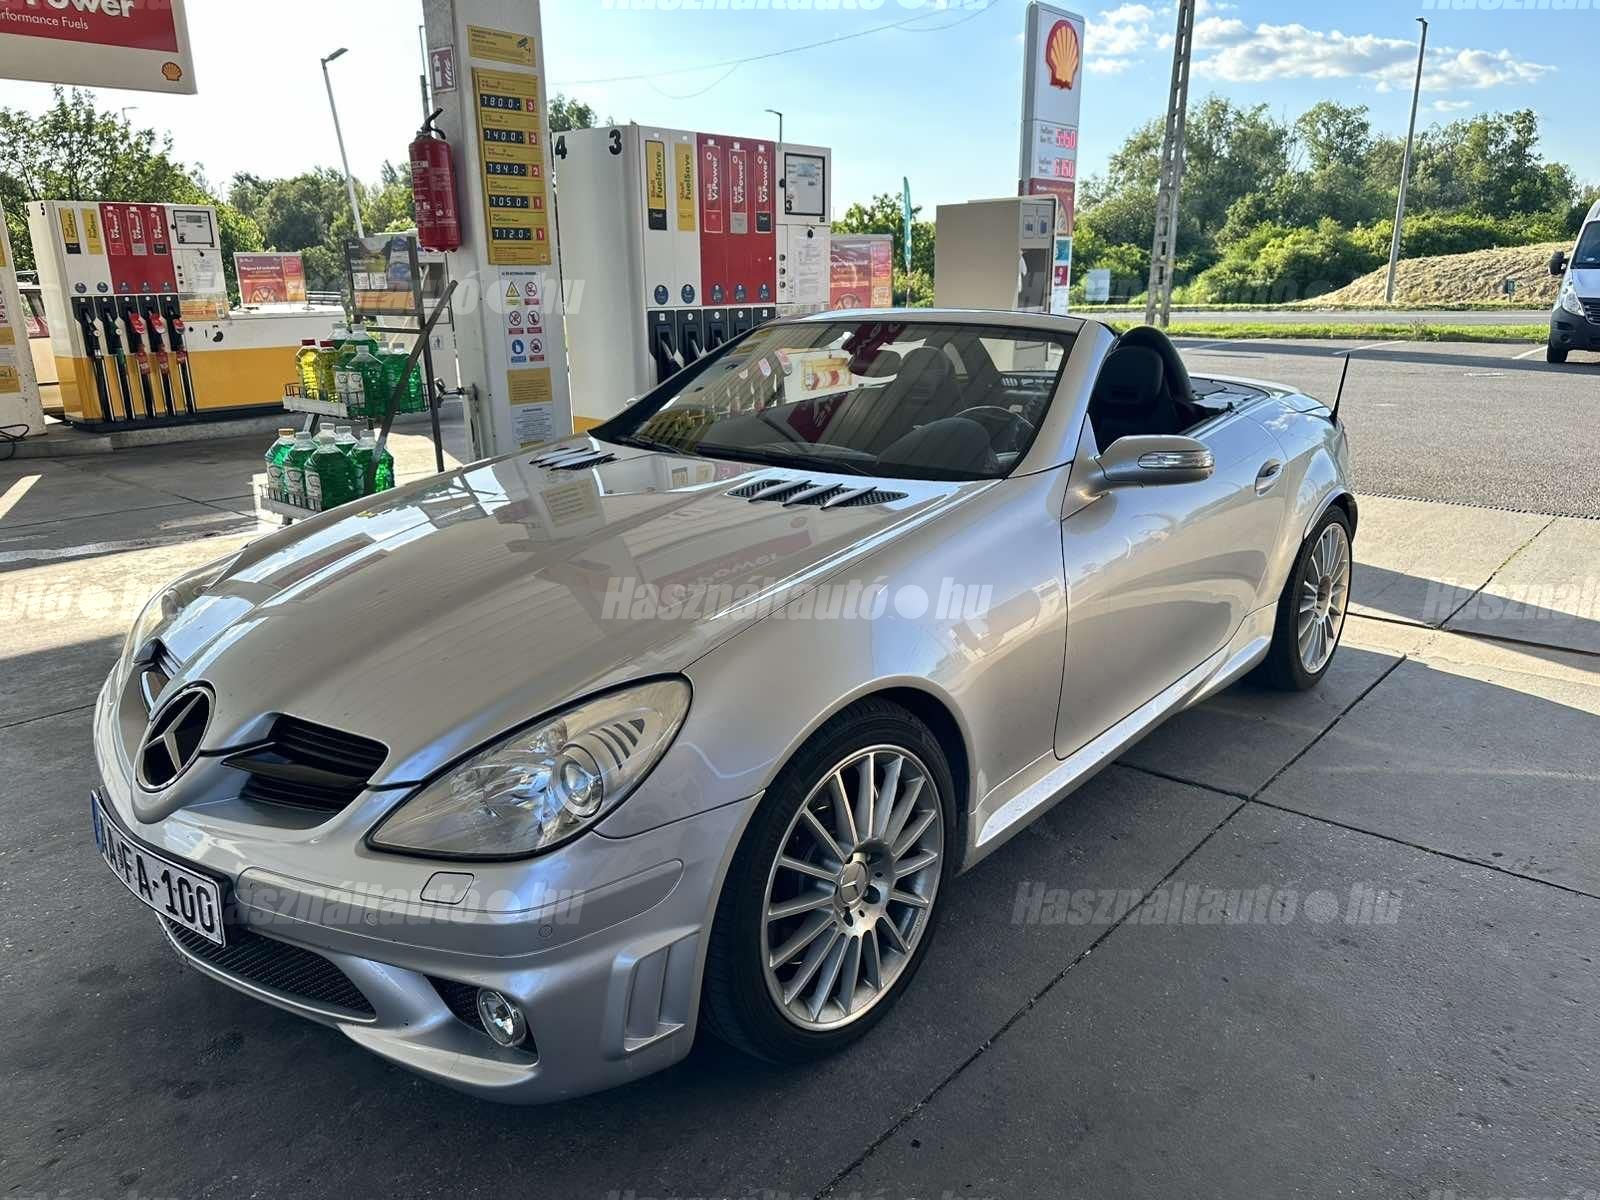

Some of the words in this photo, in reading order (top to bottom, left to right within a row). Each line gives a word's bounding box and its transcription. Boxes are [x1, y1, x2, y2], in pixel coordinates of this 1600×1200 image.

[0, 8, 58, 26] rformance
[62, 17, 89, 30] Fuels
[26, 0, 135, 17] ower
[554, 135, 567, 159] 4
[609, 129, 622, 155] 3
[656, 152, 664, 199] FuelSave
[40, 202, 46, 216] 5
[786, 199, 793, 212] 3
